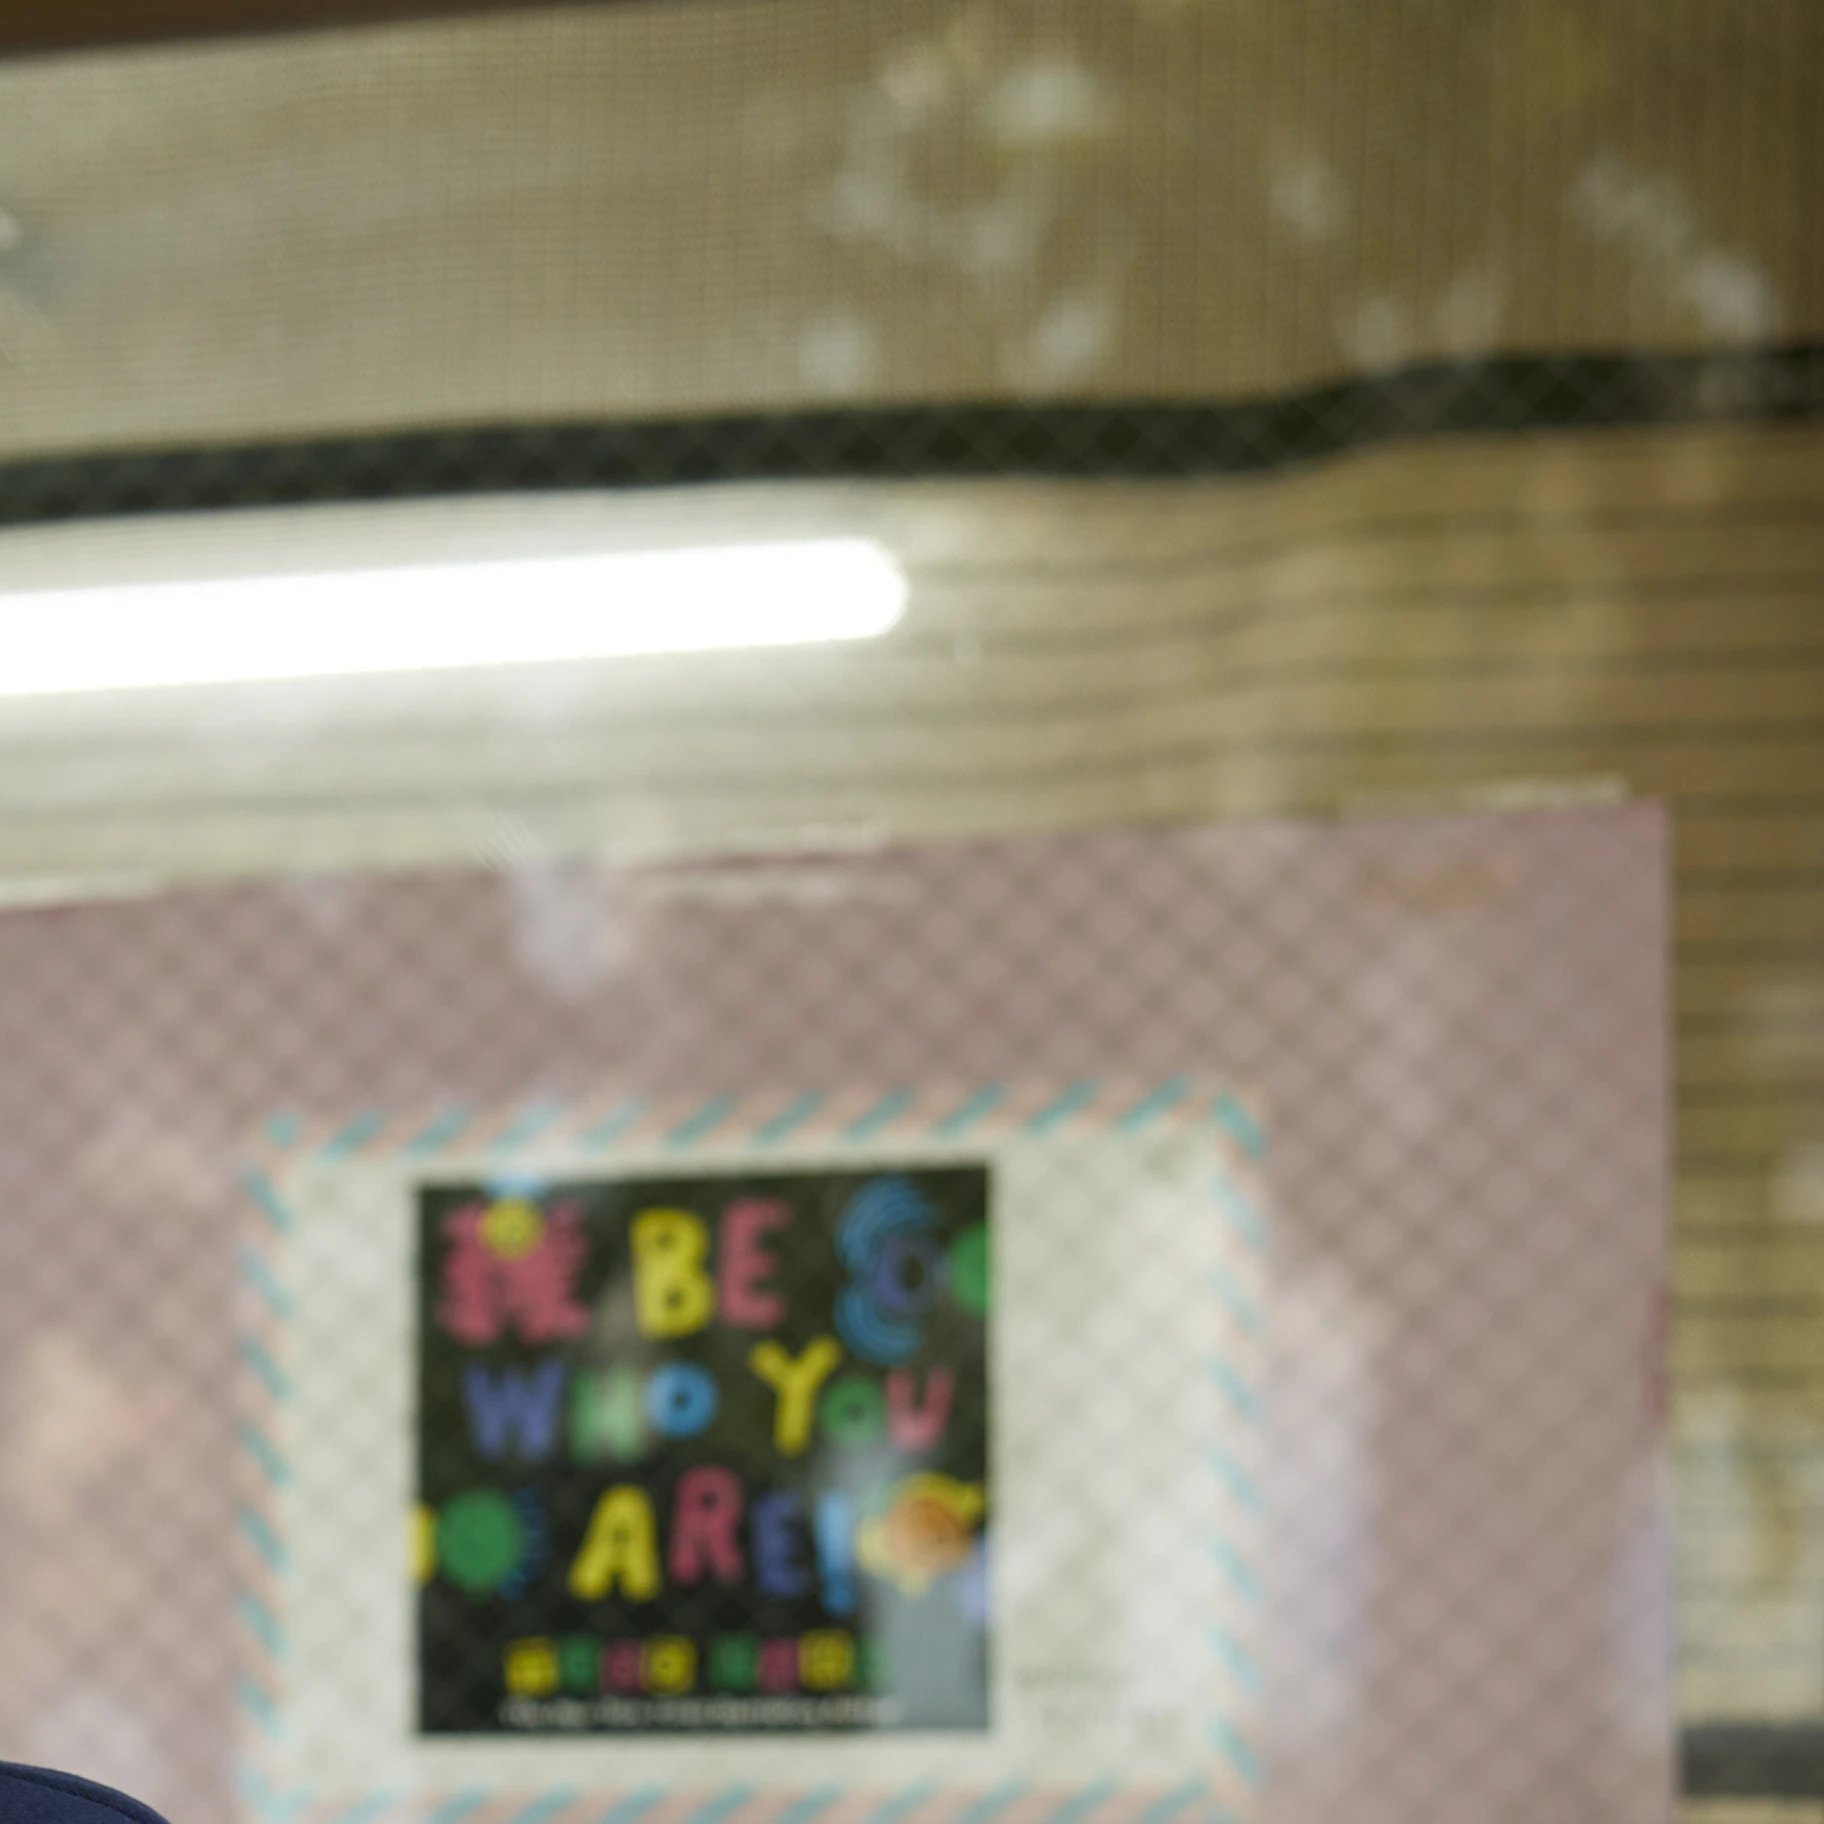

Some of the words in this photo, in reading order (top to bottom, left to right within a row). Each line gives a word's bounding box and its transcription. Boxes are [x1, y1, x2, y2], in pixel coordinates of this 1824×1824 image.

[630, 1199, 791, 1337] BE
[466, 1358, 718, 1462] WHO
[749, 1338, 954, 1453] YOU
